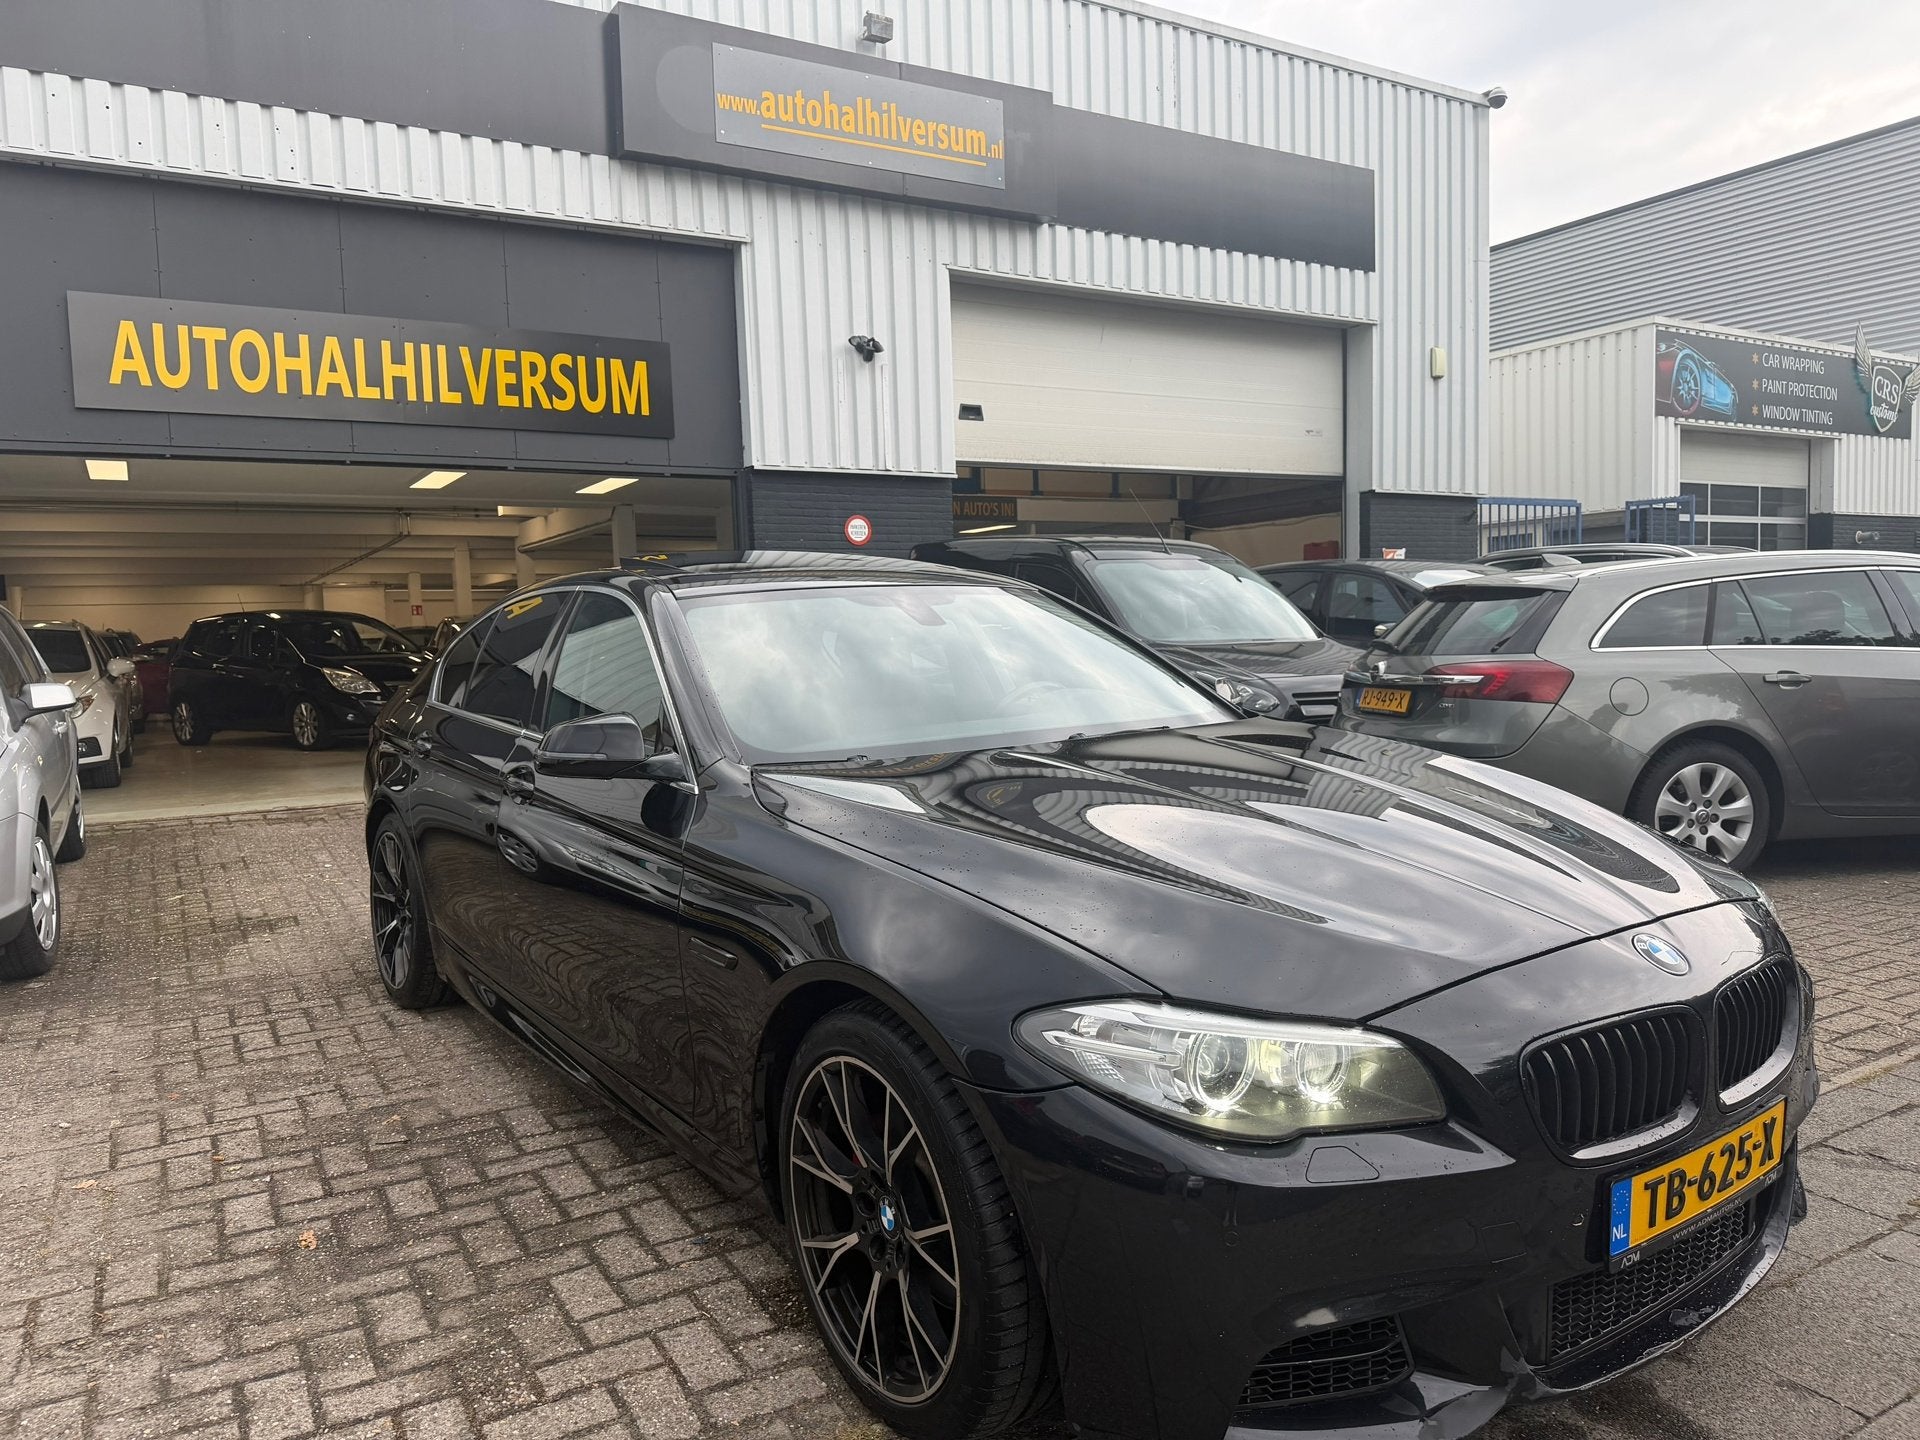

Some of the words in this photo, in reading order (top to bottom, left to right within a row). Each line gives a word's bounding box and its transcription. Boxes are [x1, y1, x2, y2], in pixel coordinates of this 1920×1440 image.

[716, 89, 1003, 160] www.autohalhilversum.nl
[109, 320, 651, 416] AUTOHALHILVERSUM
[1762, 353, 1780, 368] CAR
[1781, 355, 1825, 375] WRAPPING
[1762, 379, 1787, 394] PAINT
[1788, 382, 1838, 401] PROTECTION
[1874, 376, 1899, 404] CRS
[1762, 404, 1800, 421] WINDOW
[1801, 408, 1833, 425] TINTING
[963, 501, 999, 516] AUTO'S
[1001, 502, 1015, 517] IN!
[1361, 688, 1406, 710] RJ-949-X
[1644, 1115, 1777, 1229] TB-625-X
[1612, 1223, 1627, 1242] NL
